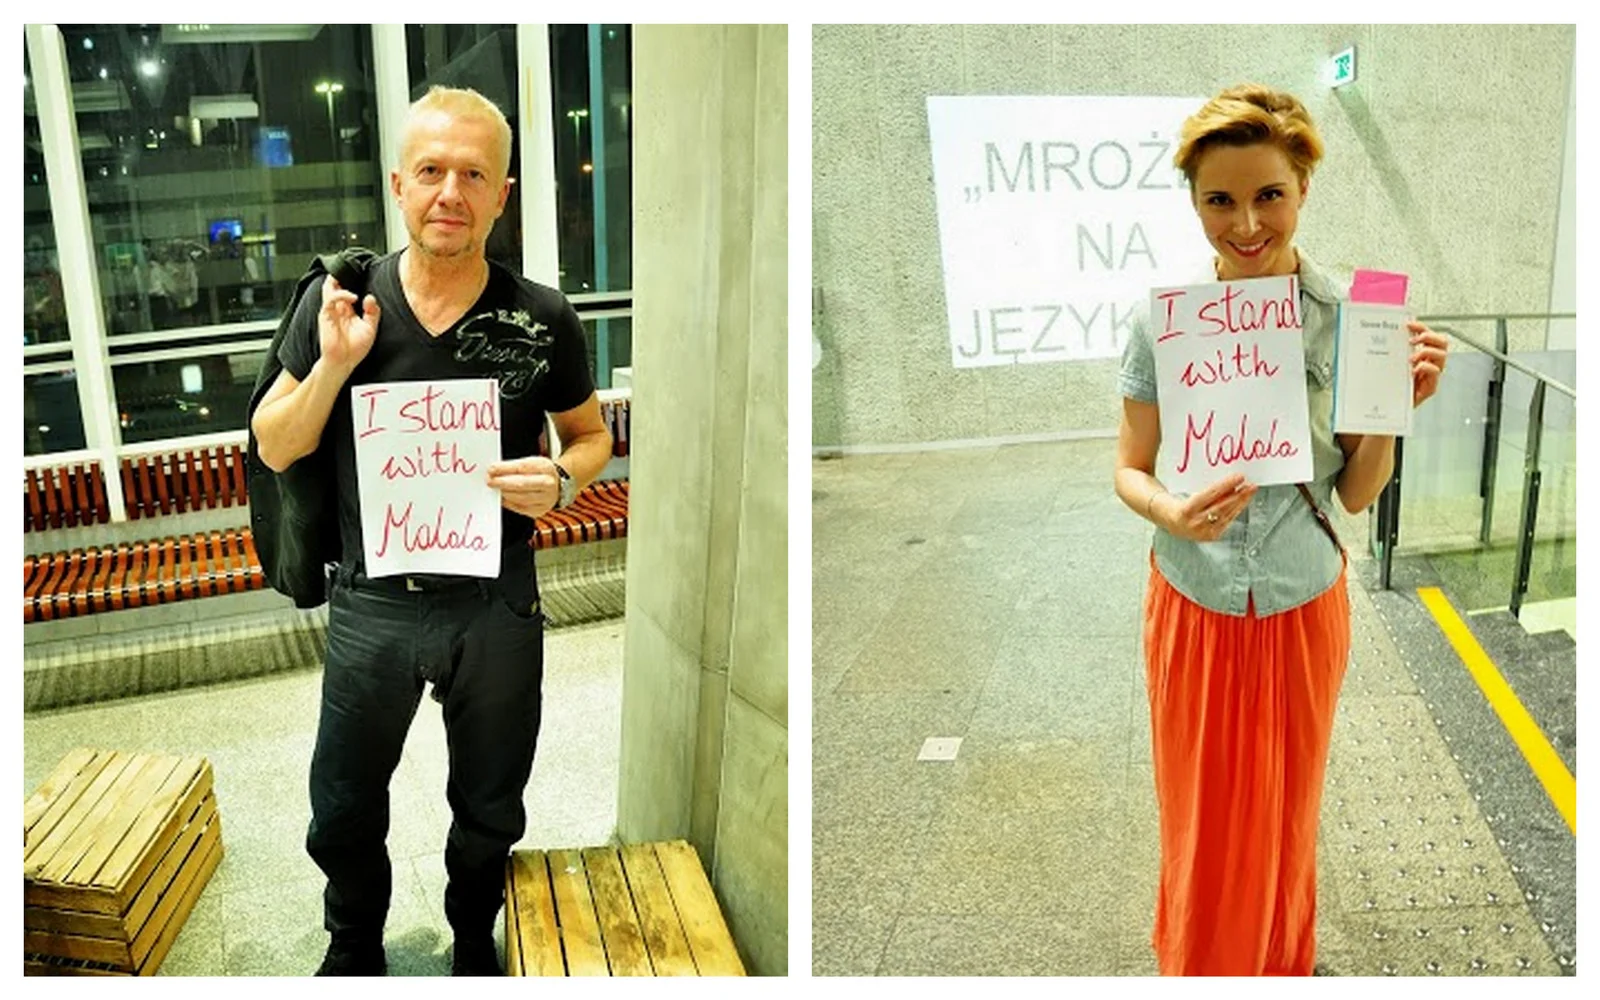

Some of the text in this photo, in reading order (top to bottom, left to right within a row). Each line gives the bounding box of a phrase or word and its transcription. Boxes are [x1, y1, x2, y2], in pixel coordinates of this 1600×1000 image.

[964, 131, 1191, 203] „MROŻ
[1076, 222, 1158, 271] NA
[1157, 276, 1304, 343] I stand
[1180, 343, 1280, 388] with
[359, 381, 501, 439] I stand
[380, 441, 477, 480] with
[1176, 410, 1299, 473] Malala
[375, 501, 490, 558] Malala
